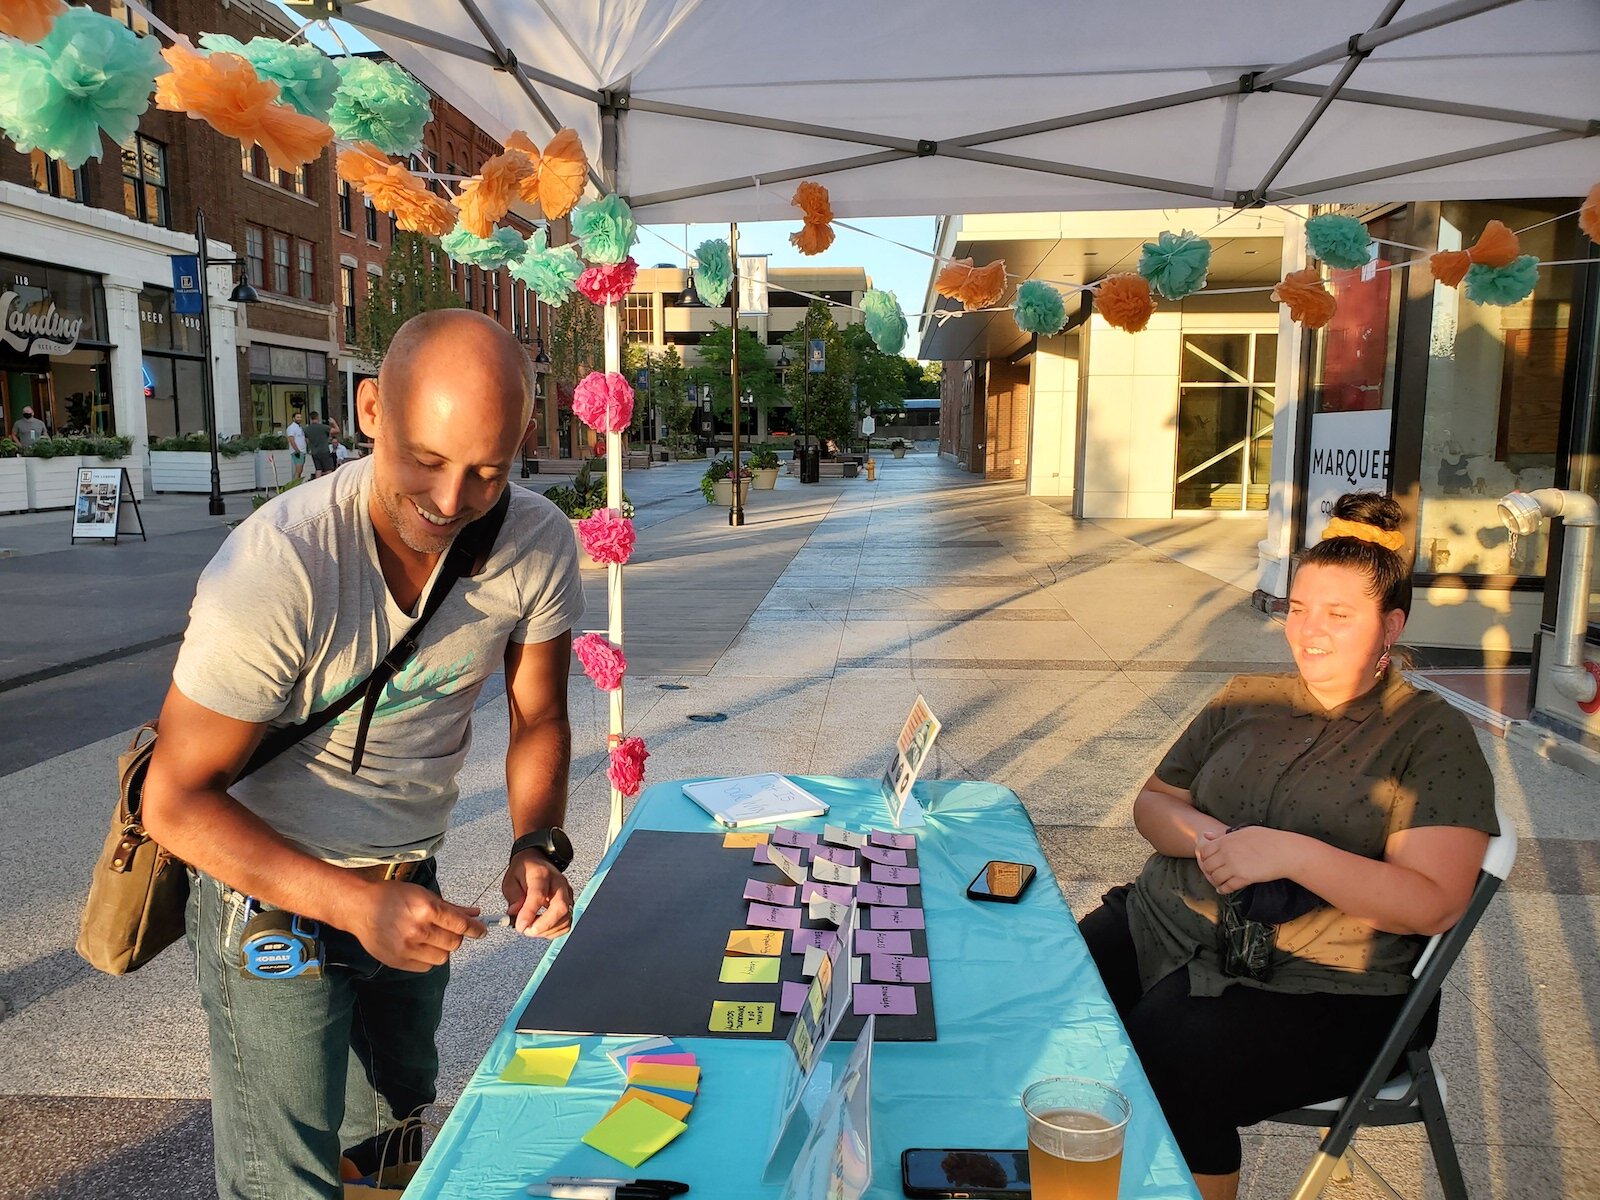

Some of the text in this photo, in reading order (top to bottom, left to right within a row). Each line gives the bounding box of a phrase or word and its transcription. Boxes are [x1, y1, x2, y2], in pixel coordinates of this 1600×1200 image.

[15, 275, 29, 286] 118
[0, 291, 83, 357] Landing
[141, 311, 163, 324] BEER
[1312, 448, 1390, 486] MARQUEE
[255, 954, 291, 962] KOBALT
